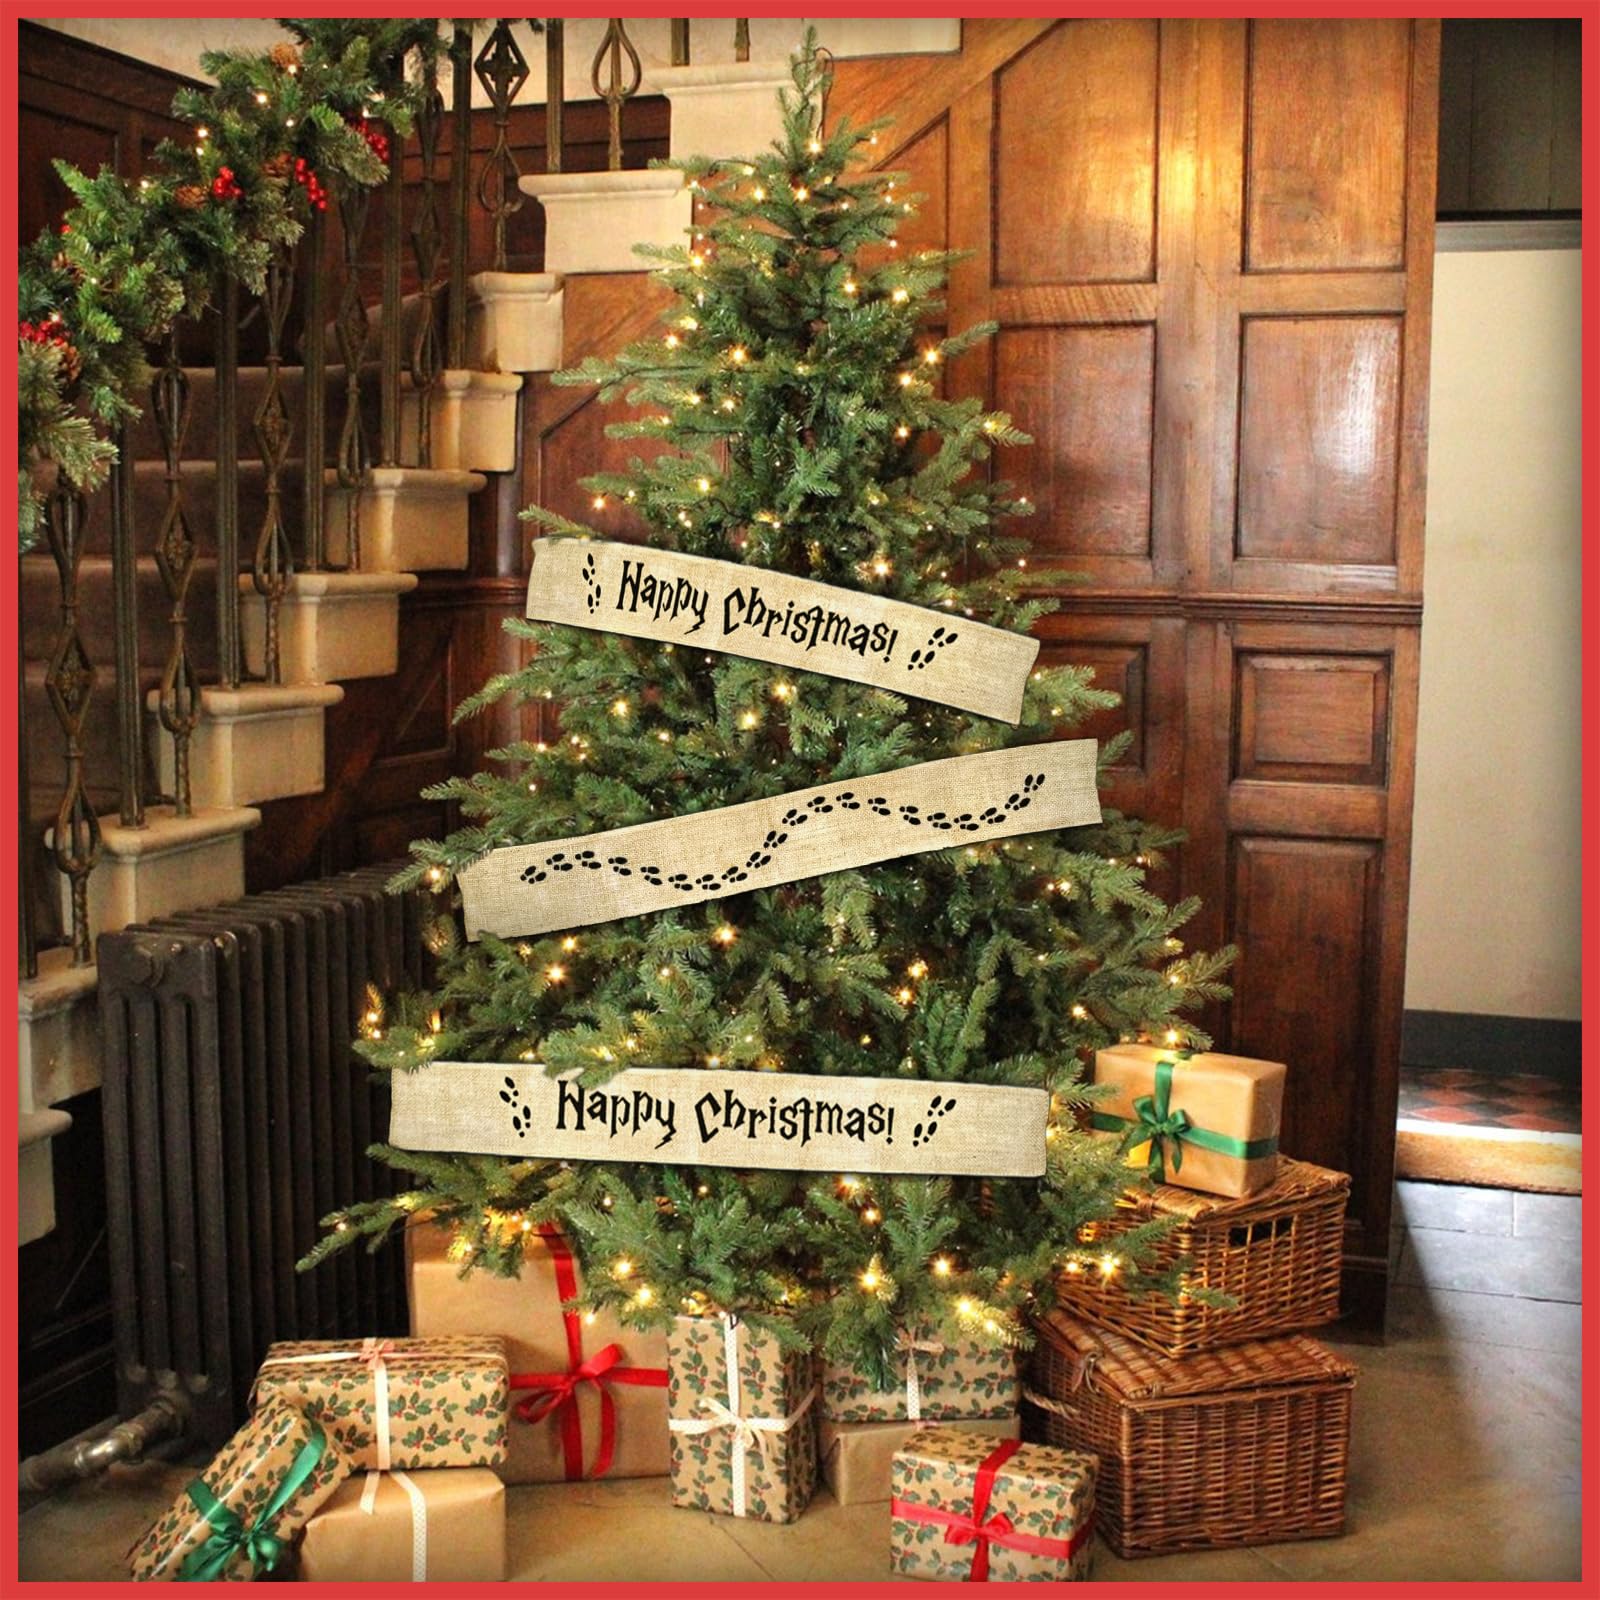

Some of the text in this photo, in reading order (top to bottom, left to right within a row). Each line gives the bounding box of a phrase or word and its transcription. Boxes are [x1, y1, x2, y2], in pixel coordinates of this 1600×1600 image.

[616, 560, 899, 663] Happy Christmas!
[556, 1079, 895, 1149] Happy Christmas!
